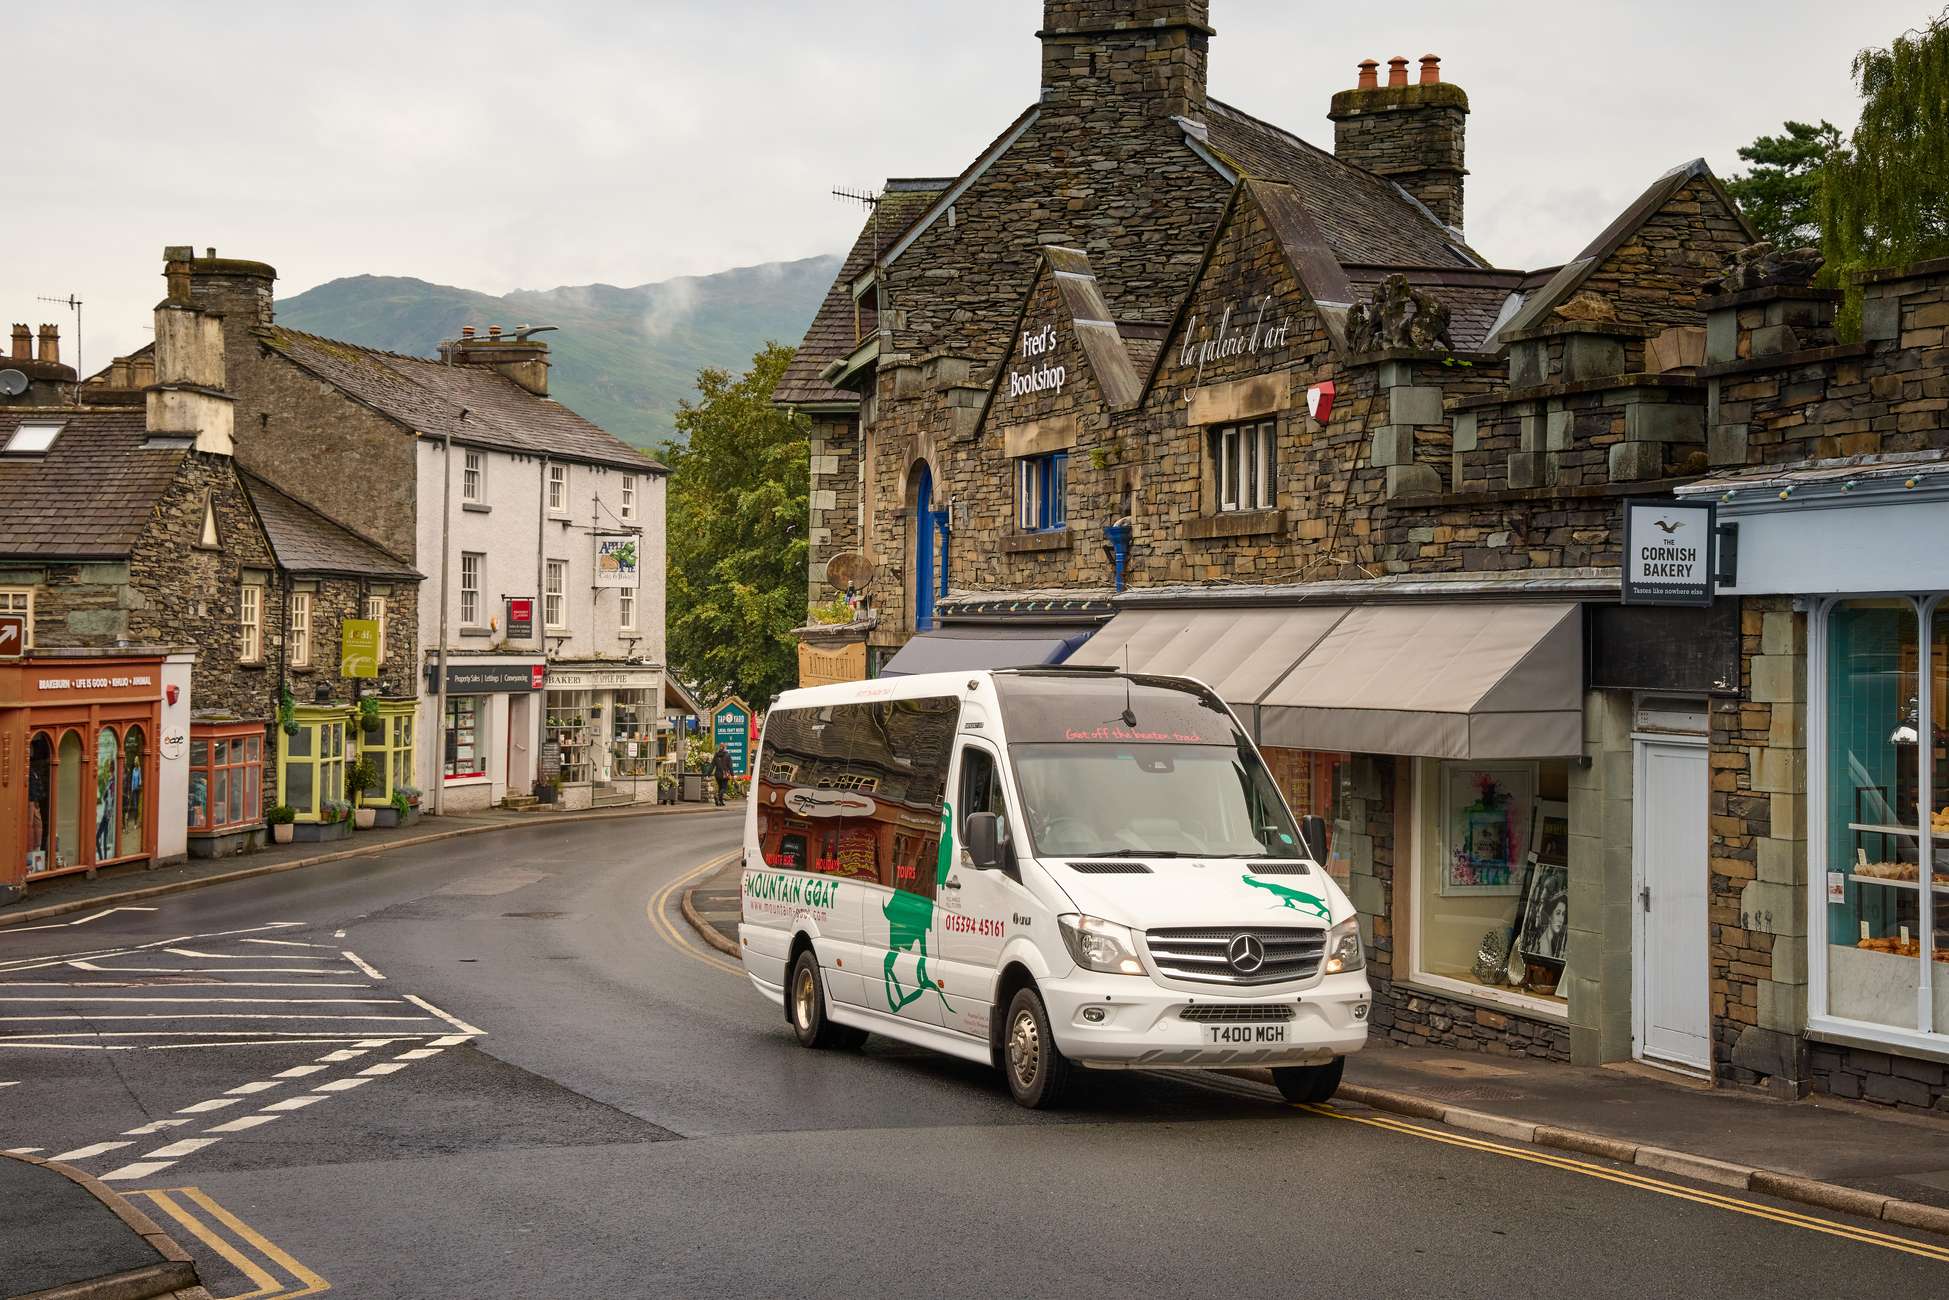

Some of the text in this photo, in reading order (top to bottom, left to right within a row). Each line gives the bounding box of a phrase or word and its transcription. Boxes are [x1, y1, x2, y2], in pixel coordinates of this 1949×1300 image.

[1023, 324, 1056, 357] Fred's
[1011, 363, 1065, 397] Bookshop
[1641, 547, 1696, 562] CORNISH
[1643, 563, 1693, 577] BAKERY
[92, 678, 108, 688] GOOD
[548, 676, 581, 684] BAKERY
[897, 866, 916, 879] TOURS
[746, 872, 803, 903] MOUNTAIN
[805, 879, 839, 909] GOAT
[946, 914, 1004, 937] 015394 45161
[1211, 1026, 1284, 1042] T400 MGH
